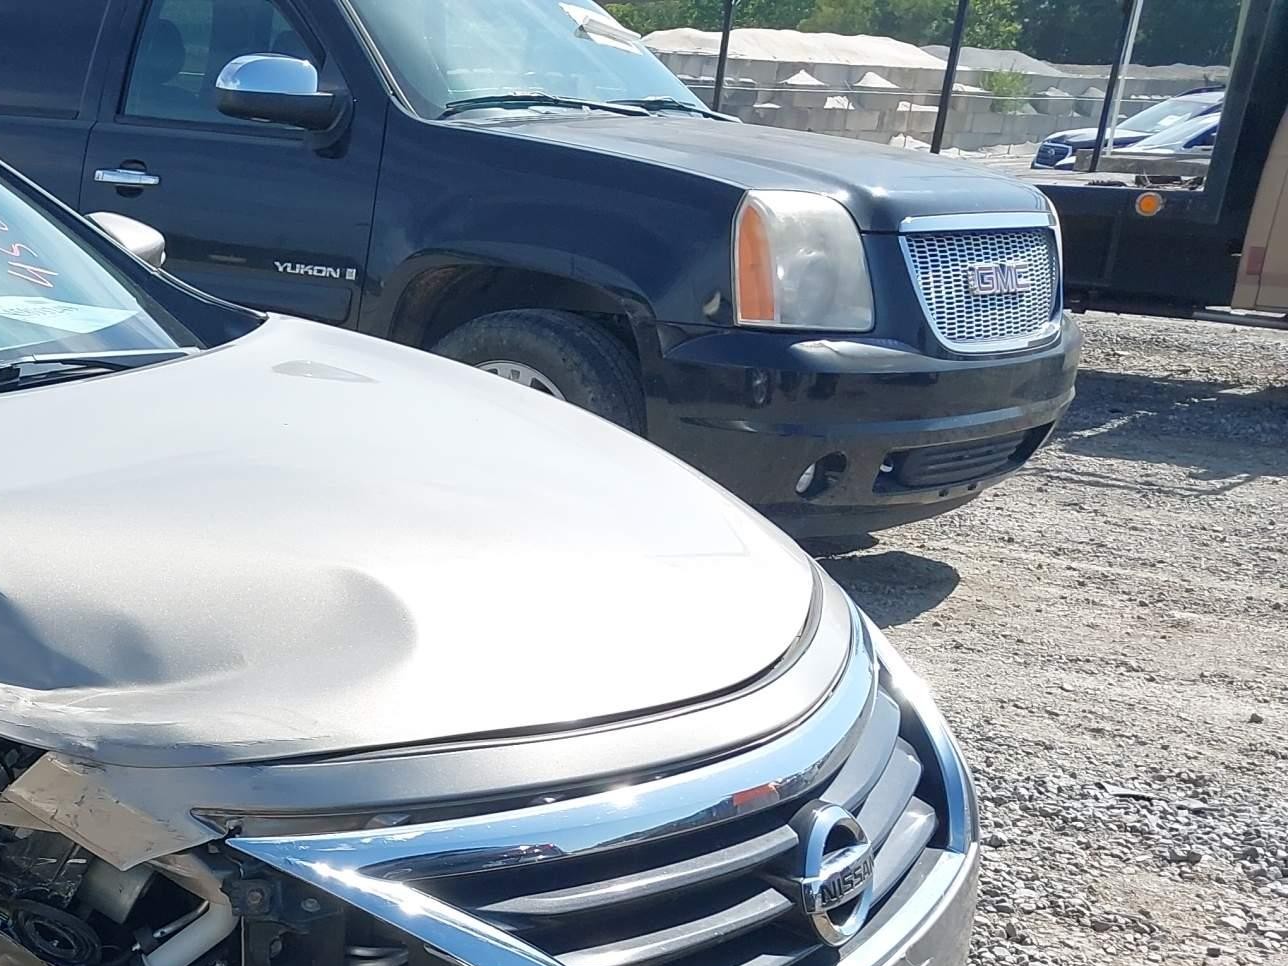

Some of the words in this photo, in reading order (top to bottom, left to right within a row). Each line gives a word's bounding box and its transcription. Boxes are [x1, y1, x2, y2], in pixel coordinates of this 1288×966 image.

[273, 261, 341, 279] YUKON
[973, 263, 1031, 294] GMC
[821, 853, 876, 905] NISSAN
